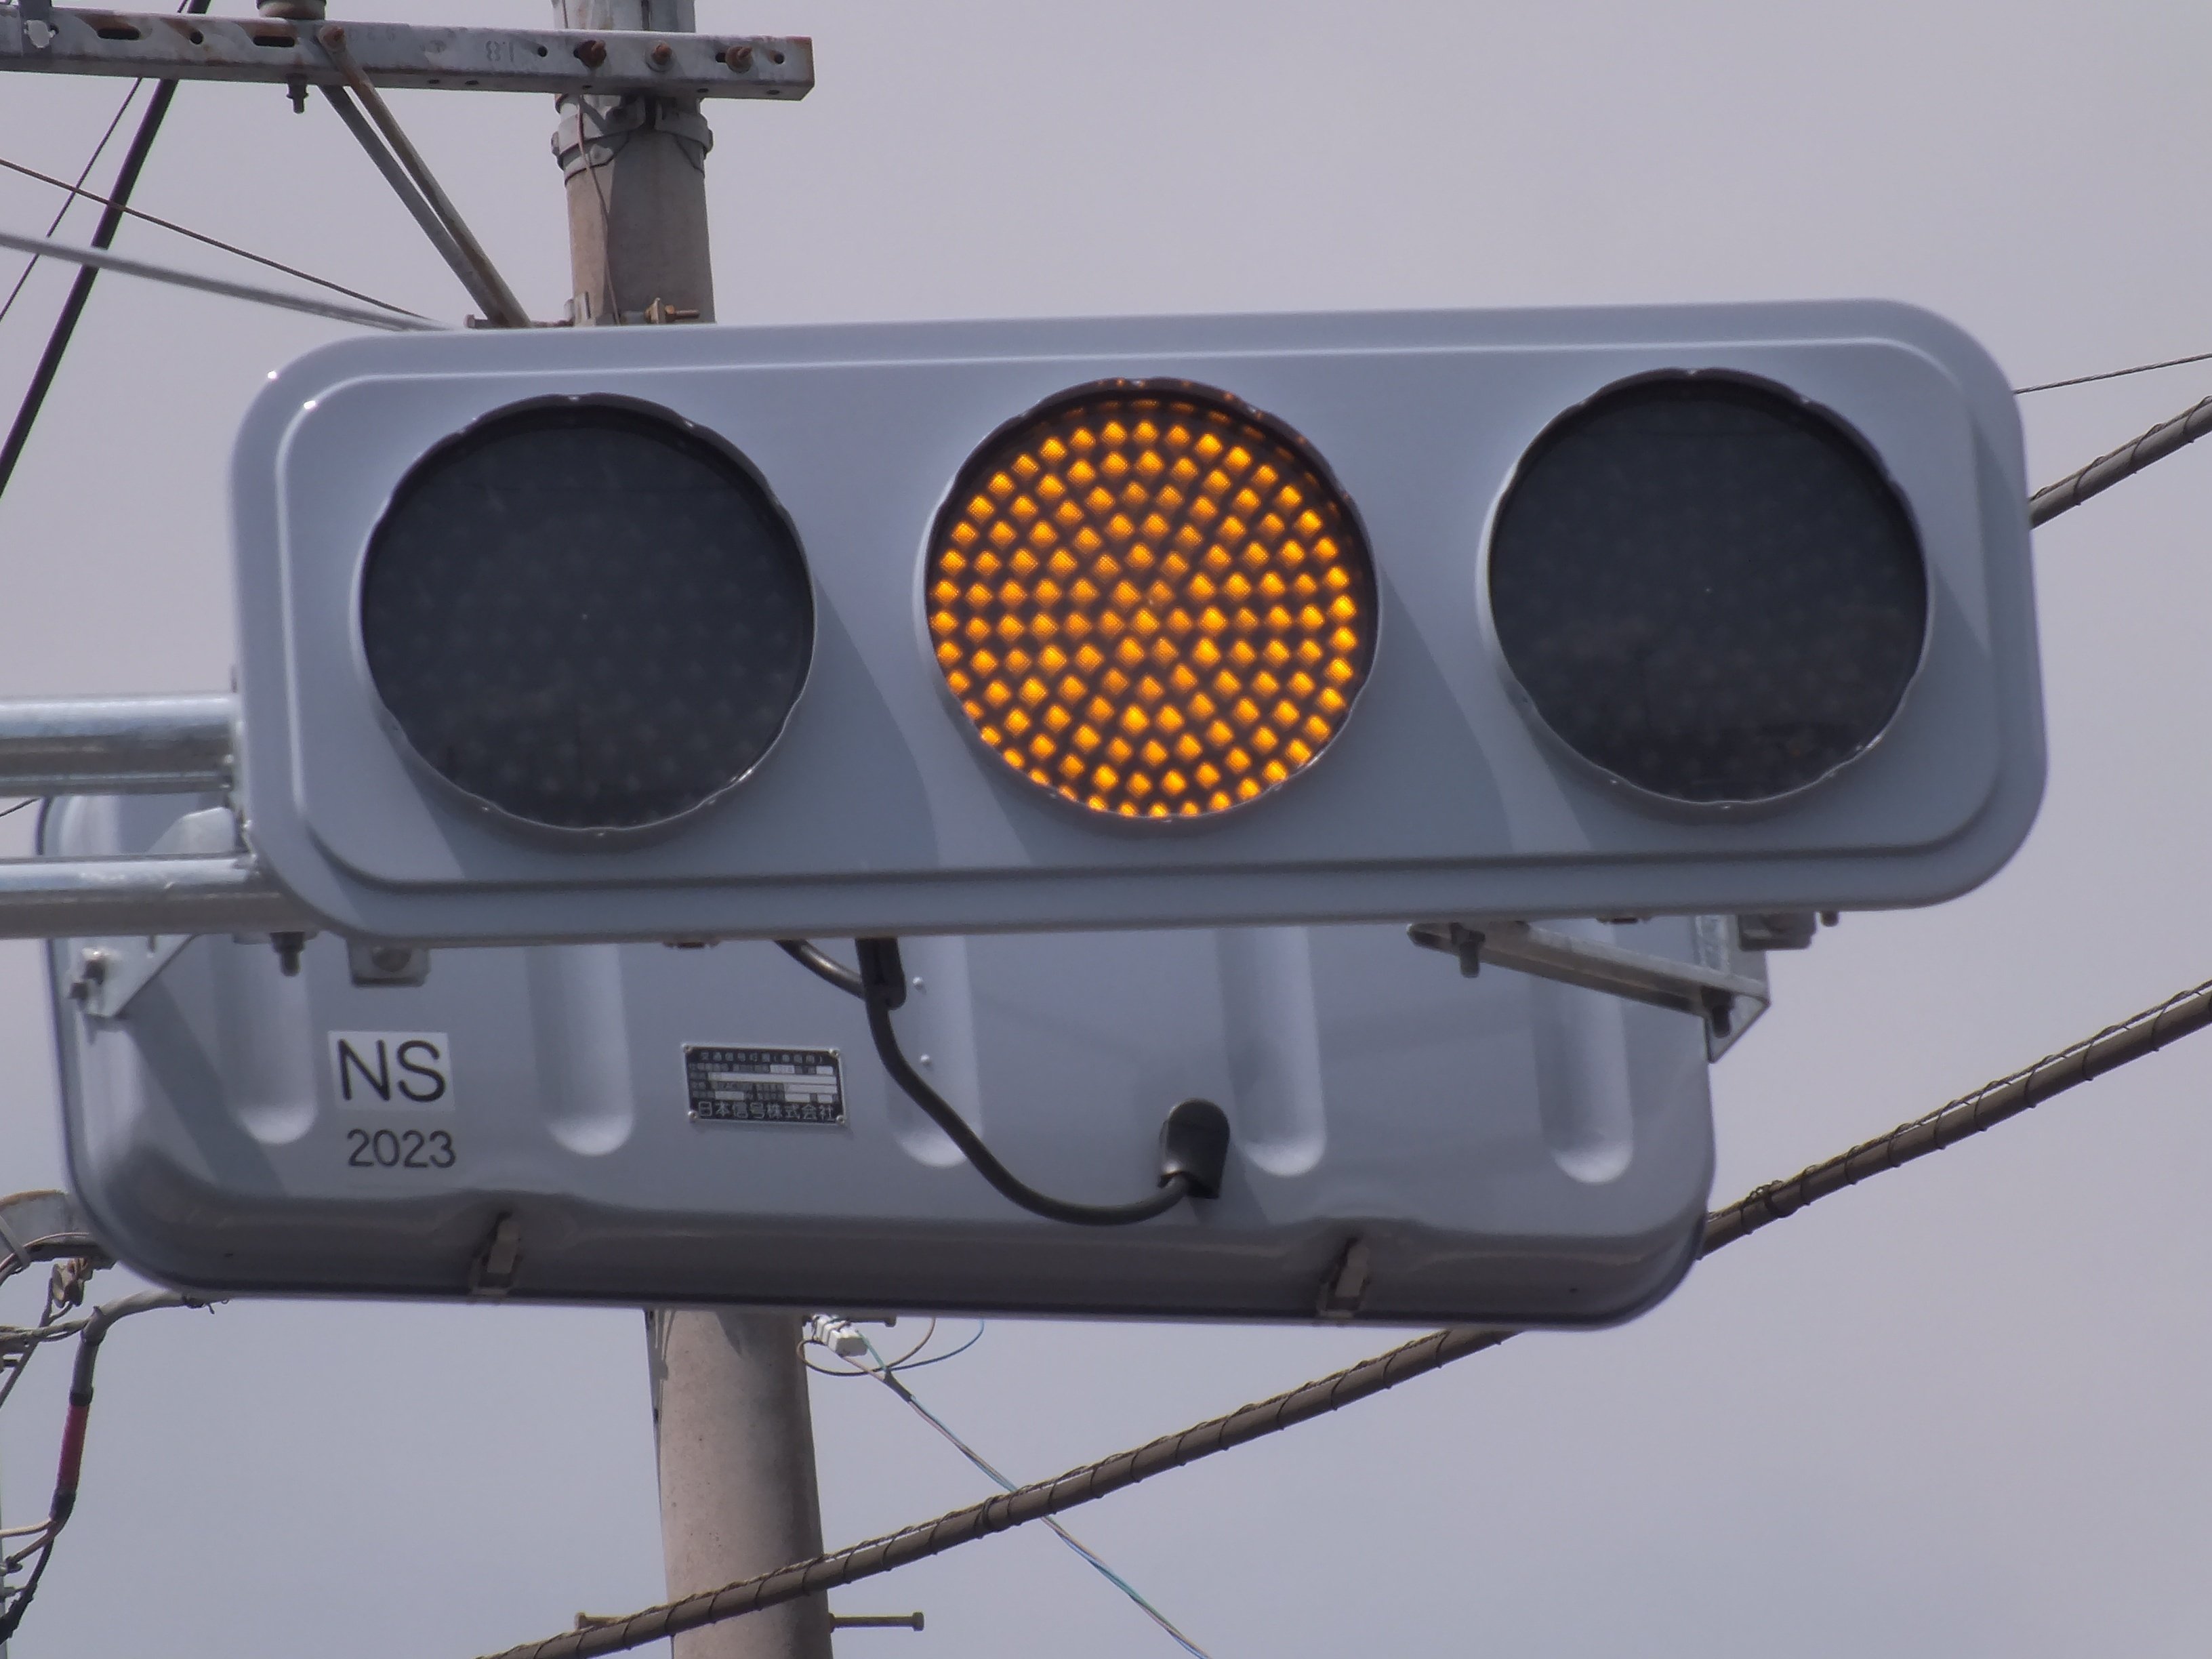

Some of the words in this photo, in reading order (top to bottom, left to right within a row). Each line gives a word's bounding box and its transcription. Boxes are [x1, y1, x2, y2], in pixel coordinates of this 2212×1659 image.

[338, 1039, 446, 1103] NS
[699, 1101, 836, 1122] 日本信号株式会社
[347, 1129, 457, 1168] 2023
